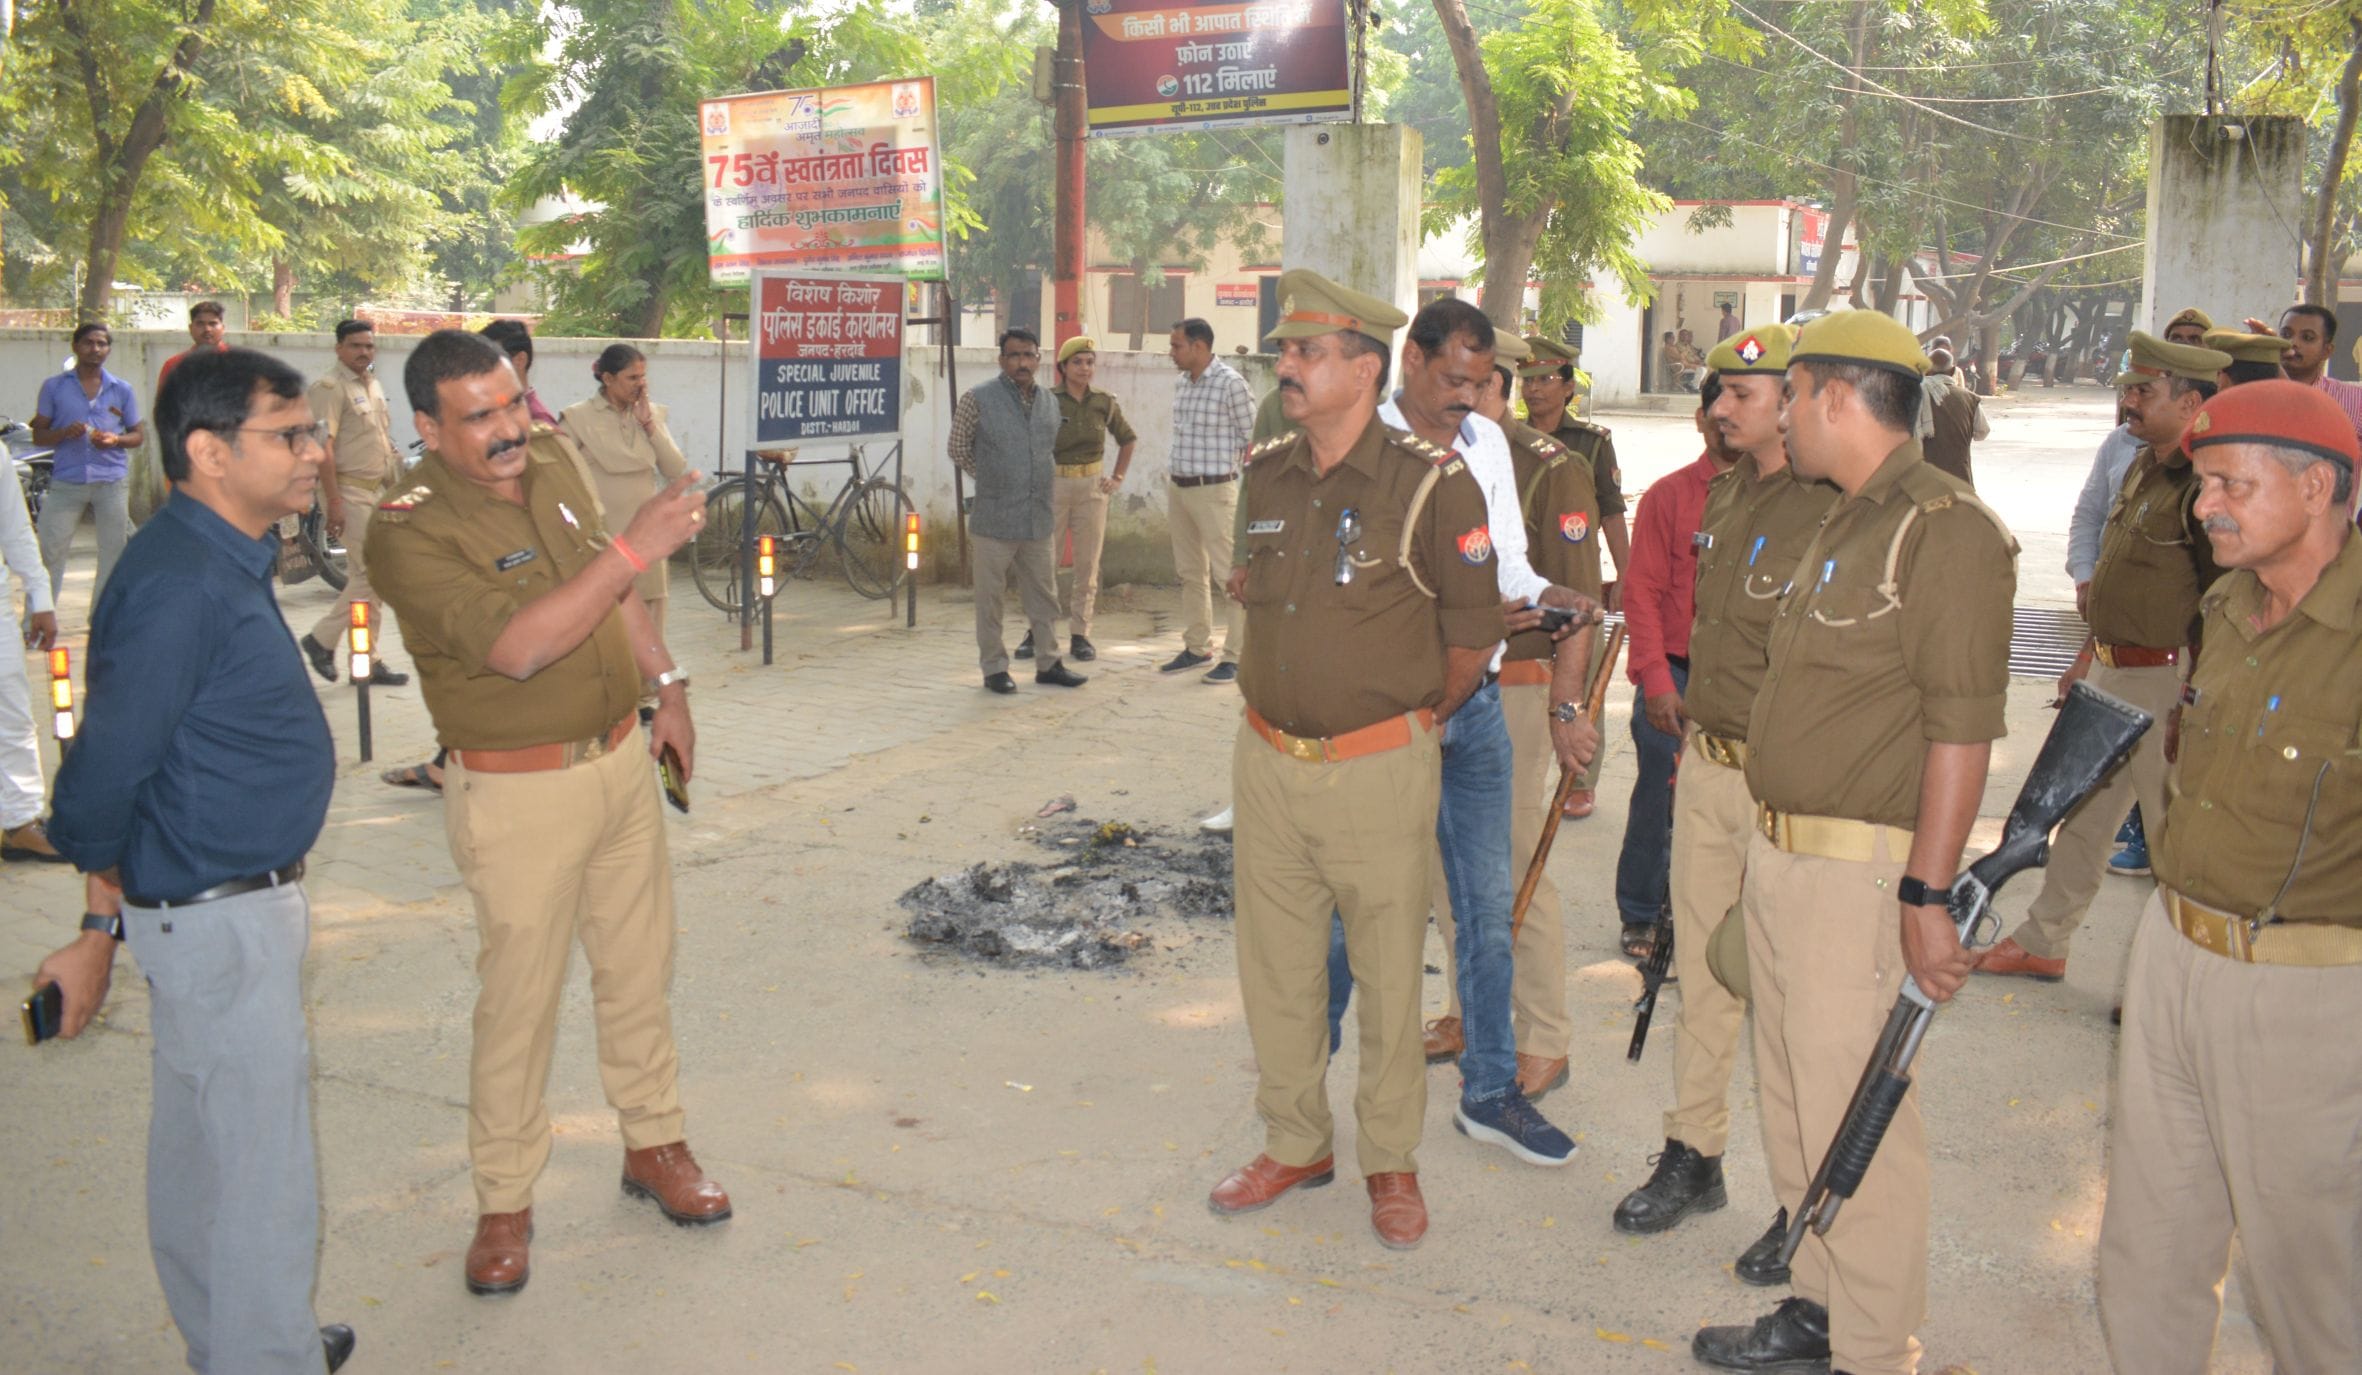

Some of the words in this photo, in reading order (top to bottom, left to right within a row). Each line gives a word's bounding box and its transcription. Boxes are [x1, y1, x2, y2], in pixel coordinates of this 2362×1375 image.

[1122, 14, 1165, 38] किसी
[1170, 12, 1191, 35] भी
[1195, 12, 1241, 33] आपात
[1183, 73, 1213, 95] 112
[1215, 64, 1277, 92] मिलाएं
[1243, 96, 1267, 111] पुलिस
[796, 131, 821, 144] अमृत
[709, 151, 779, 189] 75वें
[783, 149, 864, 184] स्वतंत्रता
[869, 143, 929, 176] दिवस
[712, 196, 722, 207] के
[761, 193, 791, 204] अवसर
[795, 191, 808, 201] पर
[812, 187, 834, 200] सभी
[838, 187, 869, 198] जनपद
[873, 181, 909, 195] वासियों
[912, 180, 927, 193] को
[736, 210, 790, 229] हार्दिक
[796, 199, 902, 230] शुभकामनाएं
[786, 280, 832, 304] विशेष
[837, 282, 882, 305] किशोर
[762, 306, 804, 344] पुलिस
[806, 306, 844, 341] इकाई
[845, 306, 898, 339] कार्यालय
[777, 364, 826, 383] SPECIAL
[830, 363, 881, 382] JUVENILE
[761, 390, 804, 420] POLICE
[809, 389, 840, 417] UNIT
[845, 388, 886, 415] OFFICE
